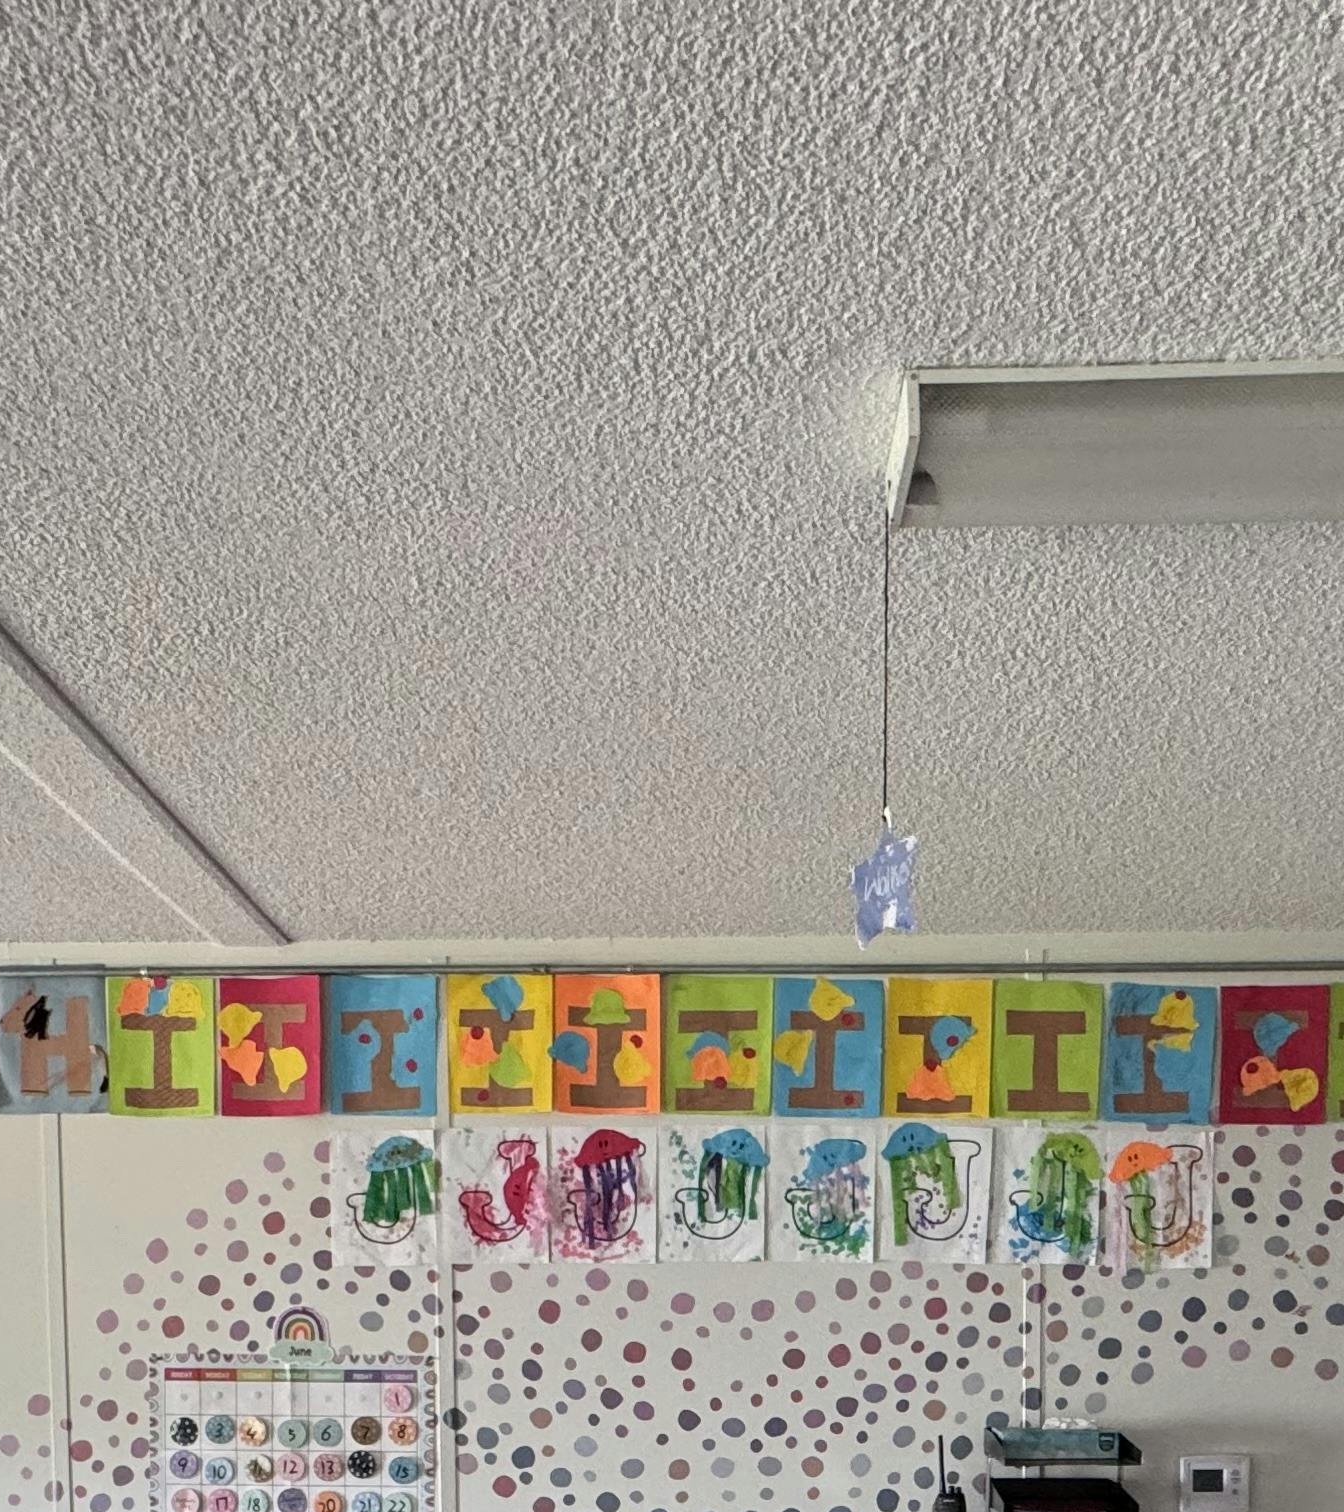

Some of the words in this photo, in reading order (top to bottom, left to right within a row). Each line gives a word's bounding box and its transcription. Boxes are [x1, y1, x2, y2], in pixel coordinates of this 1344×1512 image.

[0, 995, 92, 1096] H
[121, 1014, 200, 1109] I
[341, 1009, 422, 1112] I
[568, 1006, 647, 1107] I
[789, 1010, 865, 1109] I
[1006, 1010, 1091, 1113] I
[459, 1139, 537, 1243] J
[900, 1139, 982, 1241] J
[1123, 1145, 1204, 1247] J
[289, 1345, 313, 1358] June
[394, 1391, 402, 1407] 1
[177, 1458, 189, 1473] 9
[211, 1465, 227, 1481] 10
[282, 1459, 298, 1474] 12
[320, 1459, 335, 1474] 13
[395, 1464, 410, 1479] 15
[215, 1422, 224, 1438] 3
[245, 1427, 257, 1440] 4
[287, 1428, 297, 1443] 5
[320, 1424, 332, 1442] 6
[360, 1425, 371, 1439] 7
[396, 1423, 407, 1439] 8
[247, 1497, 260, 1512] 18
